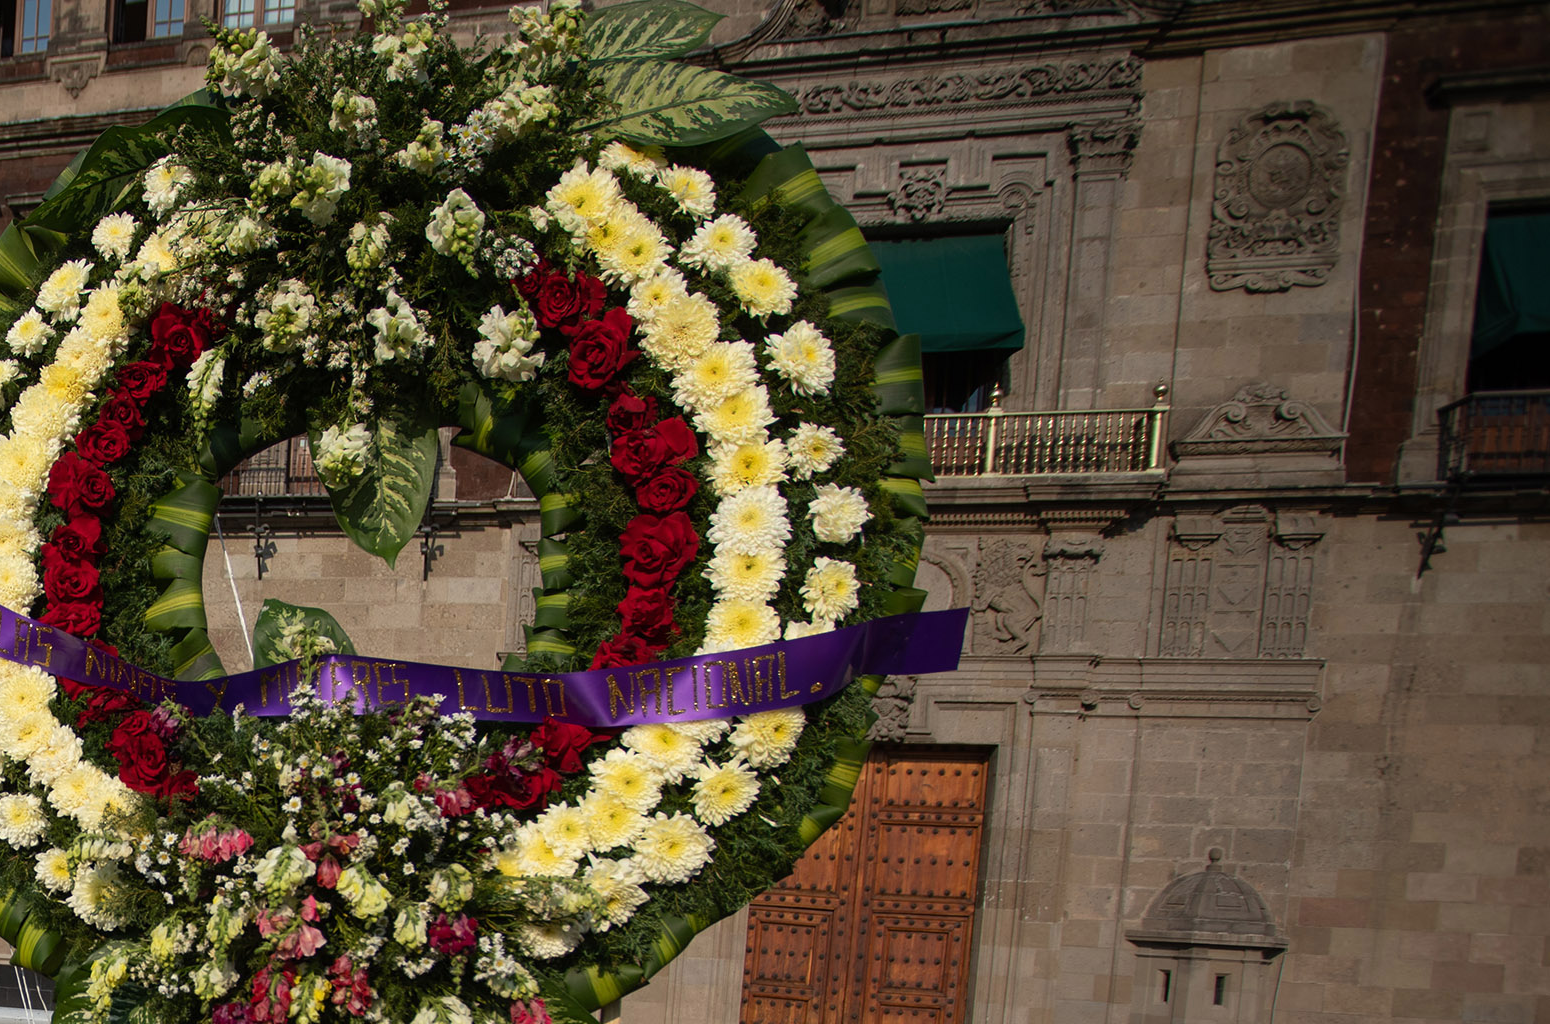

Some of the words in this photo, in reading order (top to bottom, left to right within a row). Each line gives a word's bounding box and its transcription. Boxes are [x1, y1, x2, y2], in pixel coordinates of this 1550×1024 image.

[205, 679, 228, 713] Y
[453, 669, 568, 718] LUTO
[605, 650, 823, 719] NACIONAL.
